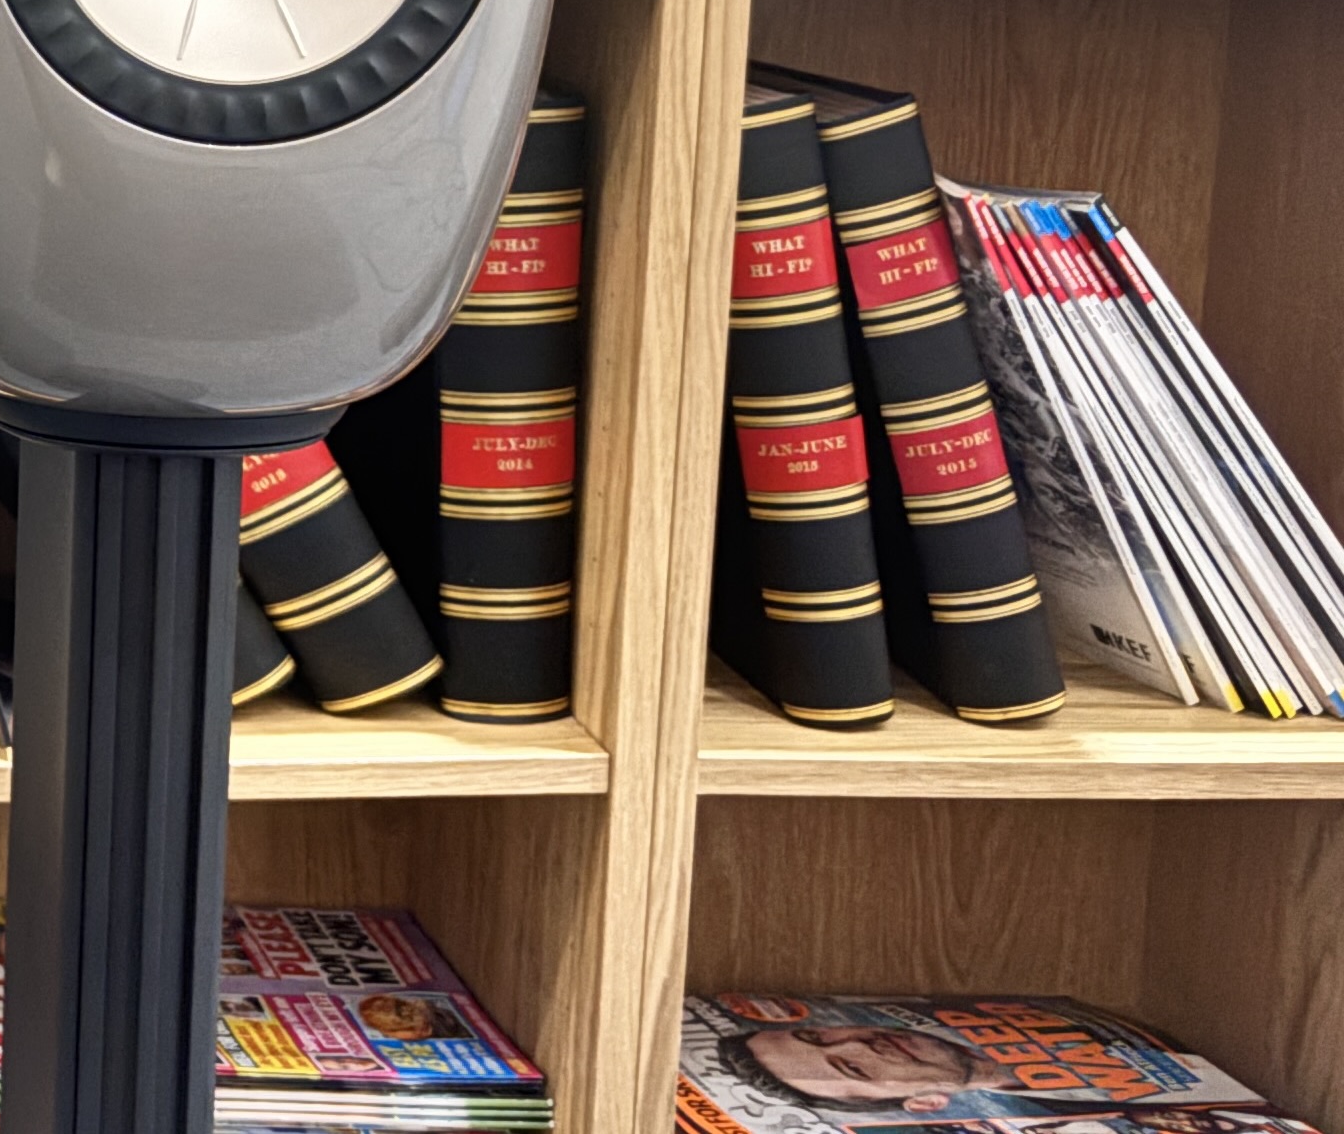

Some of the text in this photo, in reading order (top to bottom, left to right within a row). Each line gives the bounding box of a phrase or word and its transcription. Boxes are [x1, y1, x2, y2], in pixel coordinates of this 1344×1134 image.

[752, 235, 805, 255] WHAT
[876, 237, 928, 262] WHAT
[472, 435, 557, 452] JULY-DEC
[758, 434, 848, 457] JAN-JUNE
[905, 428, 993, 459] JULY-DEC
[936, 457, 977, 477] 2015
[254, 910, 321, 978] PLEASE
[934, 1009, 1090, 1090] DEEP
[980, 1002, 1168, 1102] WATER
